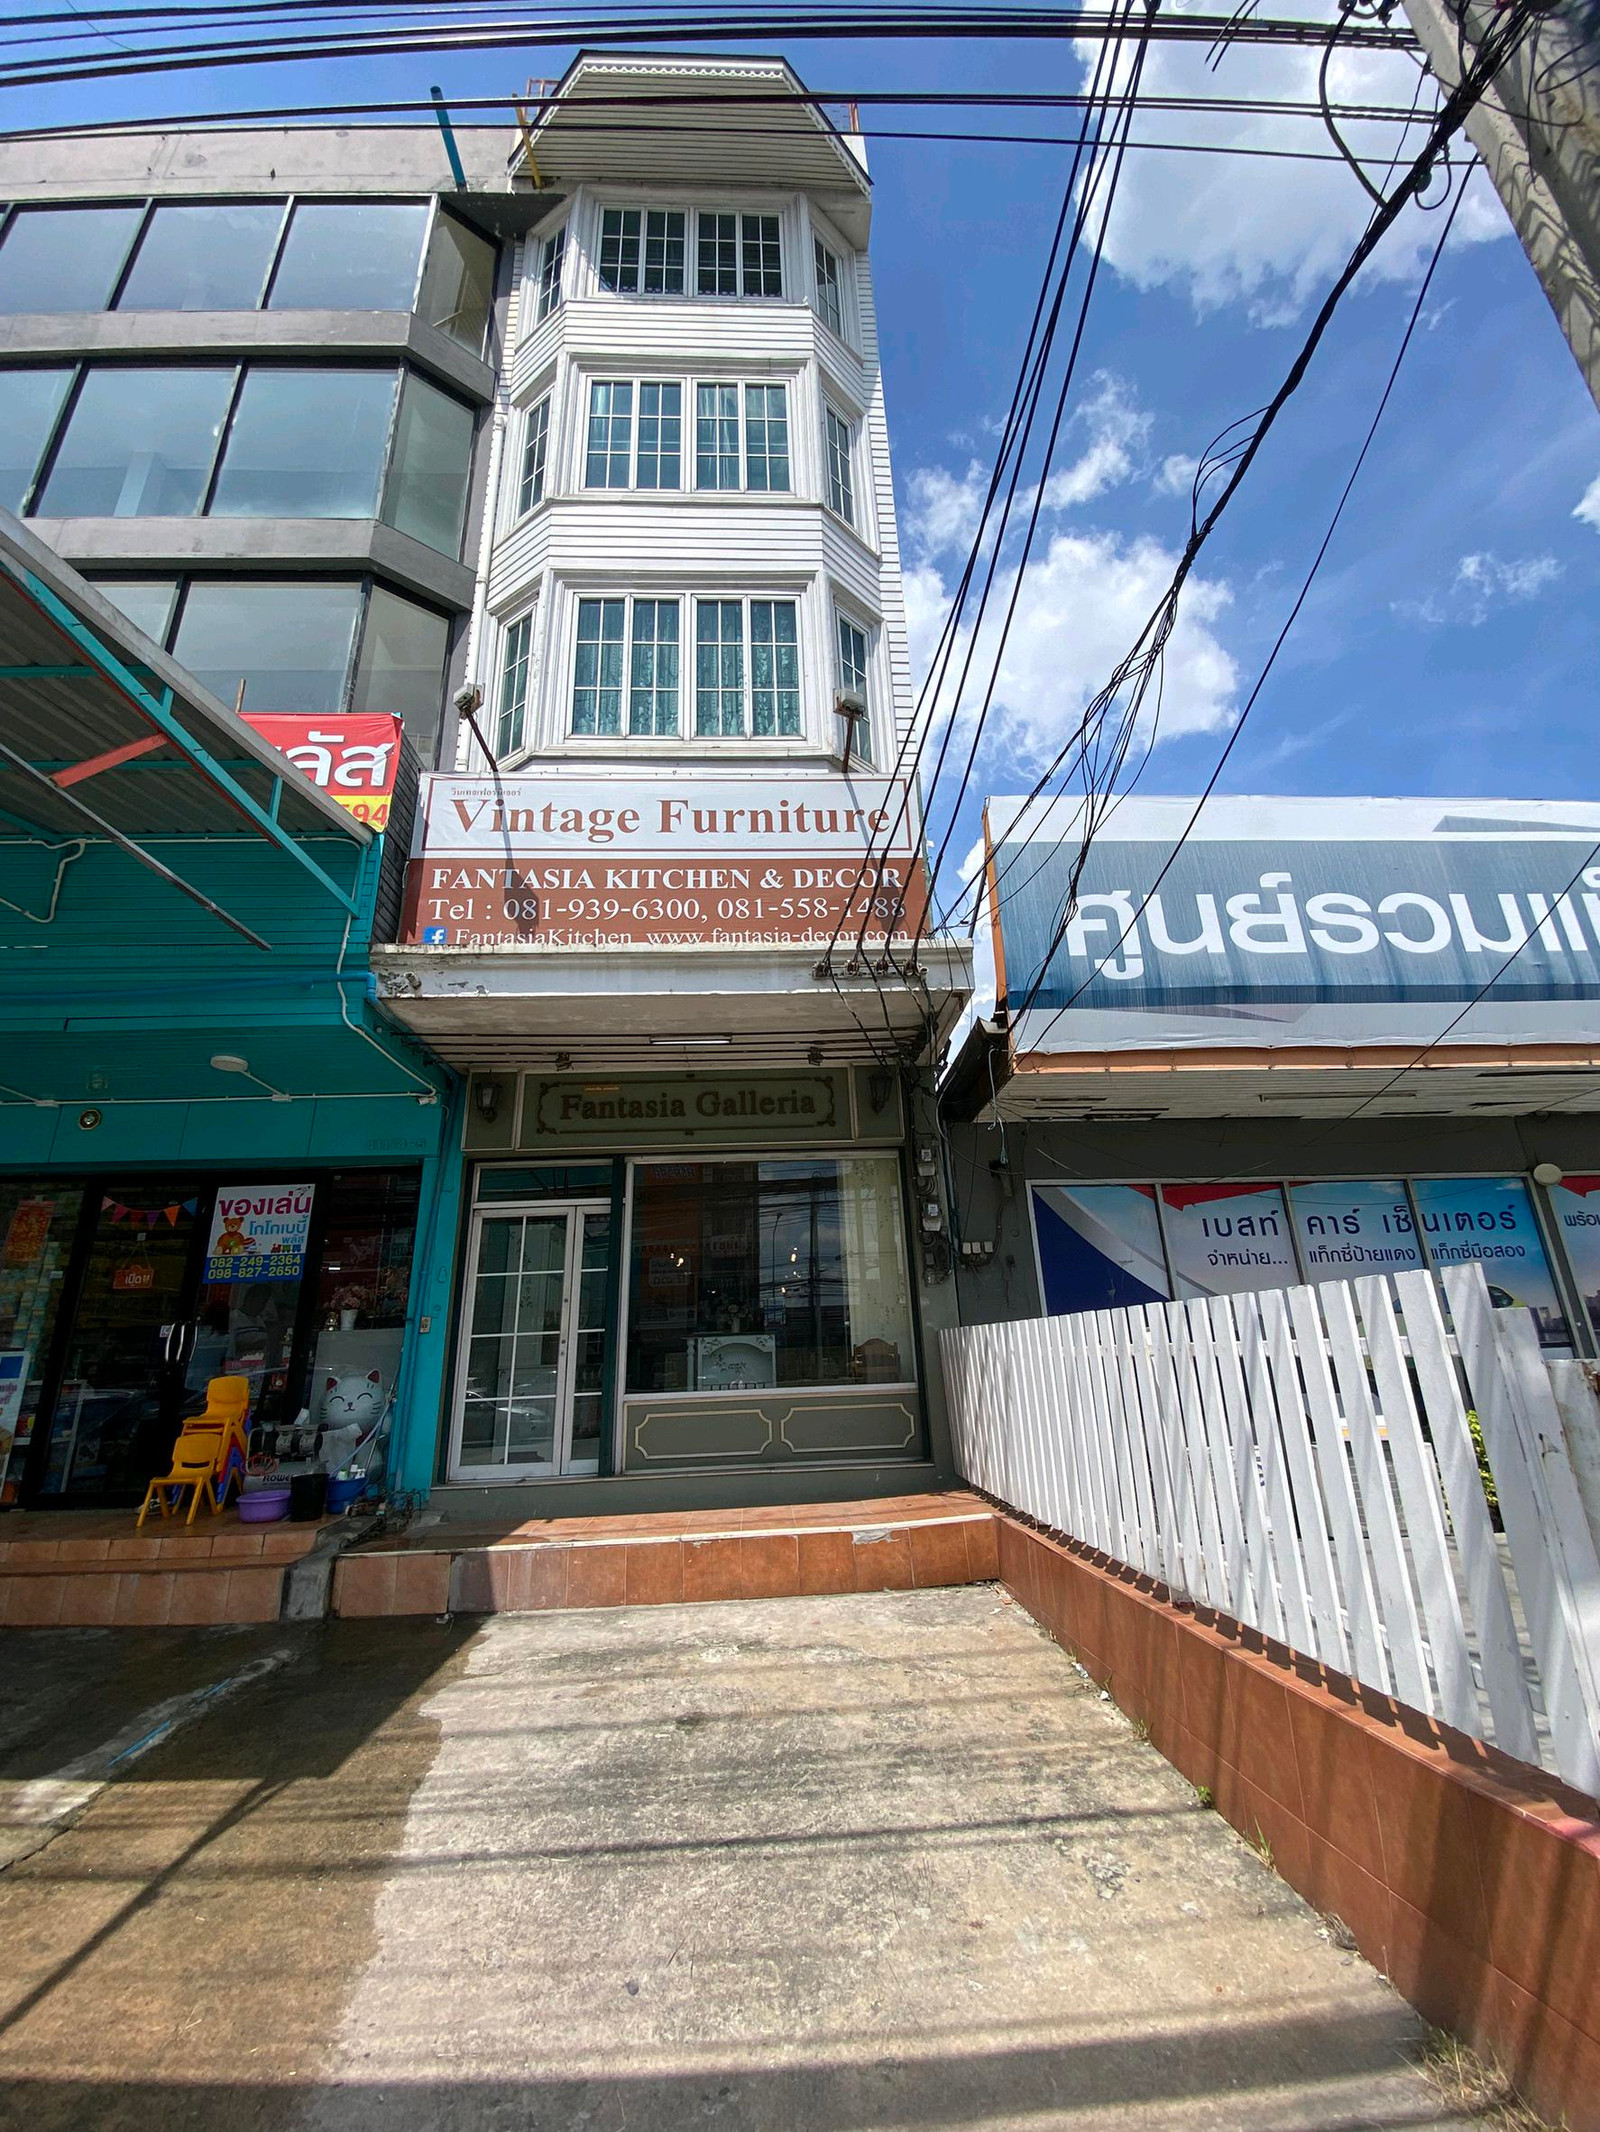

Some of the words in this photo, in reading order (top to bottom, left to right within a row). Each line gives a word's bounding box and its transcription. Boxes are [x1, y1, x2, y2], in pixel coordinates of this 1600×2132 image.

[275, 731, 396, 787] ลัส
[340, 804, 388, 826] 94
[450, 799, 640, 844] Vintage
[656, 799, 890, 834] Furniture
[430, 868, 596, 889] FANTASIA
[604, 868, 751, 889] KITCHEN
[759, 868, 785, 889] &
[793, 868, 904, 889] DECOR
[428, 898, 474, 920] Tel
[503, 898, 708, 924] 081-939-6300,
[718, 898, 906, 920] 081-558-1488
[454, 928, 632, 945] FantasiaKitchen
[646, 928, 908, 945] www.fantasia-decorcom
[559, 1092, 687, 1120] Fantasia
[696, 1089, 817, 1117] Galleria
[218, 1190, 312, 1217] ของเล่น
[1202, 1210, 1279, 1238] เบสท์
[1306, 1208, 1361, 1236] คาร์
[1382, 1204, 1517, 1234] เซ็นเตอร์
[210, 1255, 301, 1269] 082-249-2364
[1207, 1248, 1288, 1266] จำหน่าย...
[1309, 1242, 1416, 1264] แท็กซี่ป้ายแดง
[1430, 1239, 1526, 1260] แท็กซี่มือสอง
[208, 1265, 300, 1279] 098-827-2650
